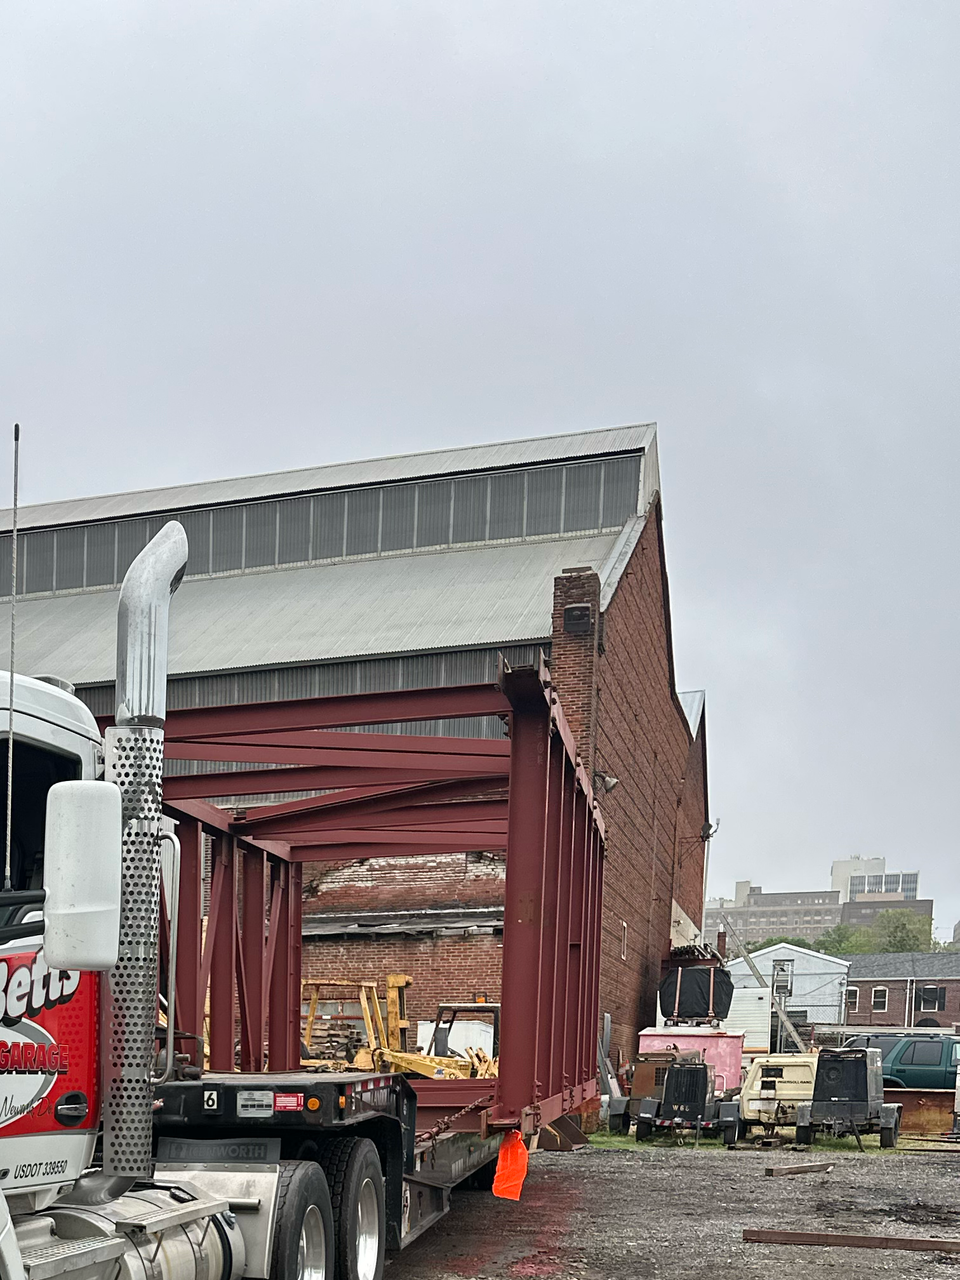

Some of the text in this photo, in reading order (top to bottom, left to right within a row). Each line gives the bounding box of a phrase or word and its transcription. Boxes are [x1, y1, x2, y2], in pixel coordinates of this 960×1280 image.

[206, 1092, 215, 1107] 6
[14, 1162, 43, 1180] USDOT
[42, 1160, 68, 1177] 339550
